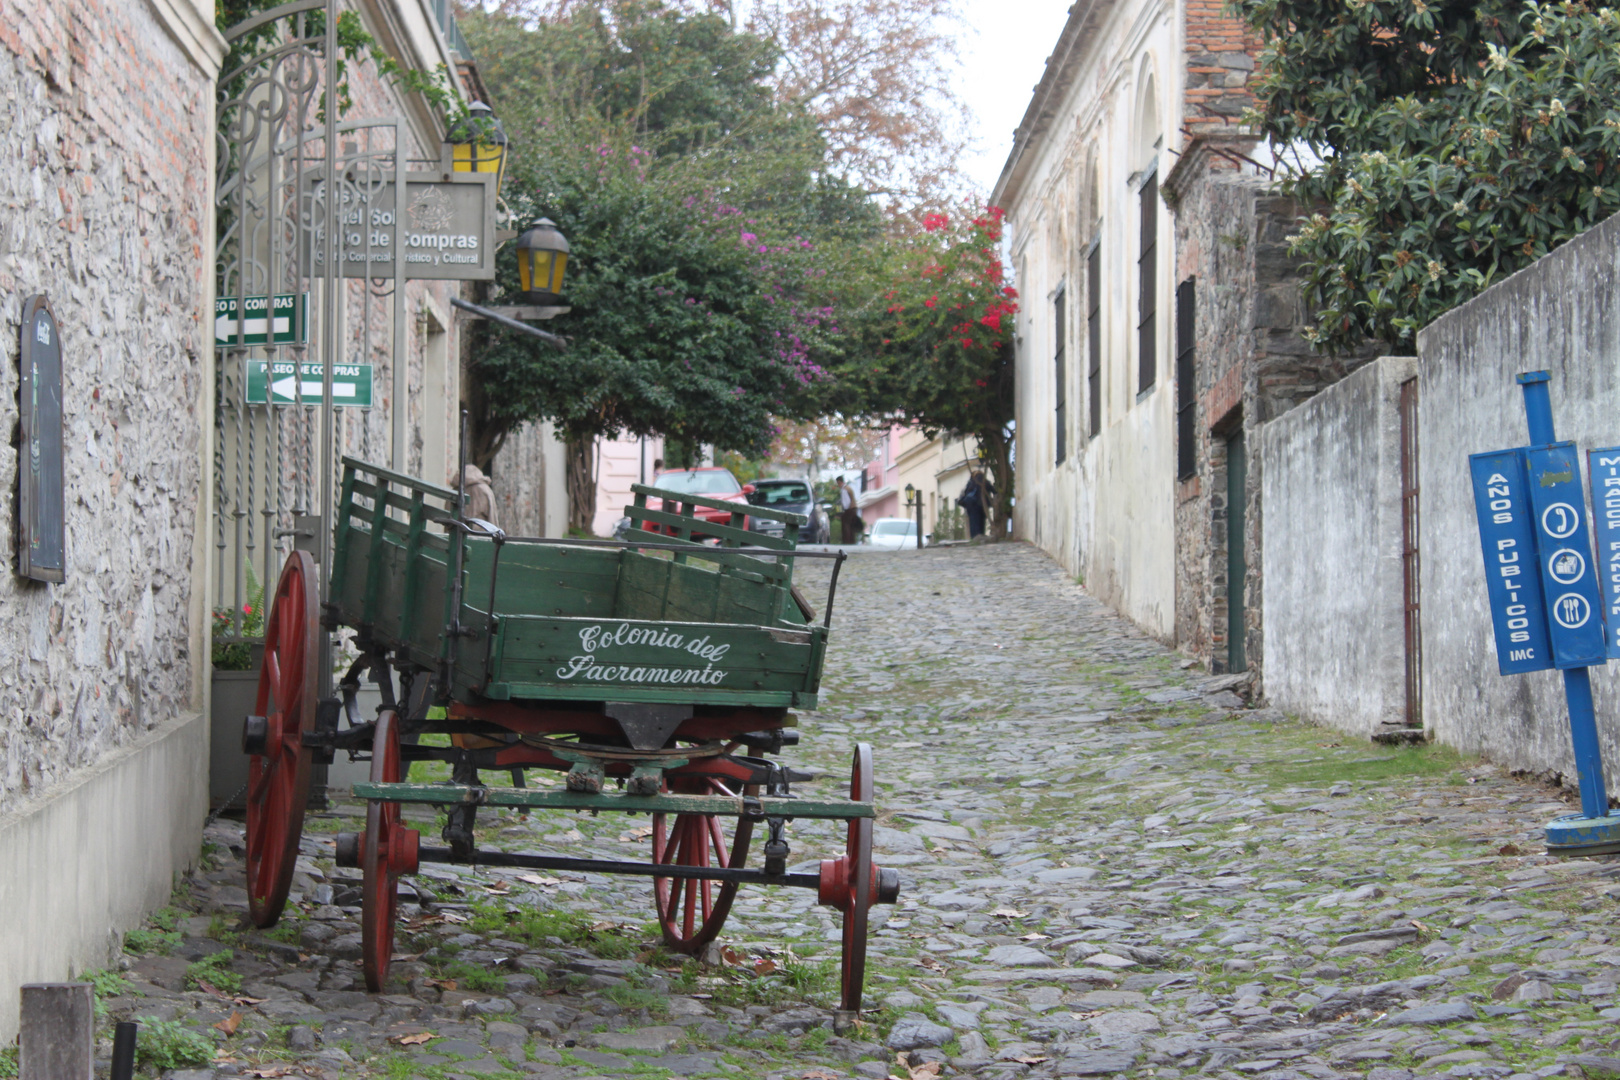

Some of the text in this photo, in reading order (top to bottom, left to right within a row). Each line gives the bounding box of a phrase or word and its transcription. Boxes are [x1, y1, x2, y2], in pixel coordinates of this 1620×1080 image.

[370, 230, 390, 247] de
[442, 252, 478, 264] Cultural
[245, 297, 294, 310] COMRAS
[1497, 538, 1530, 643] PUBLICOS
[578, 622, 731, 662] Colonia del
[1509, 648, 1535, 662] IMC
[556, 654, 728, 685] Sacramento
